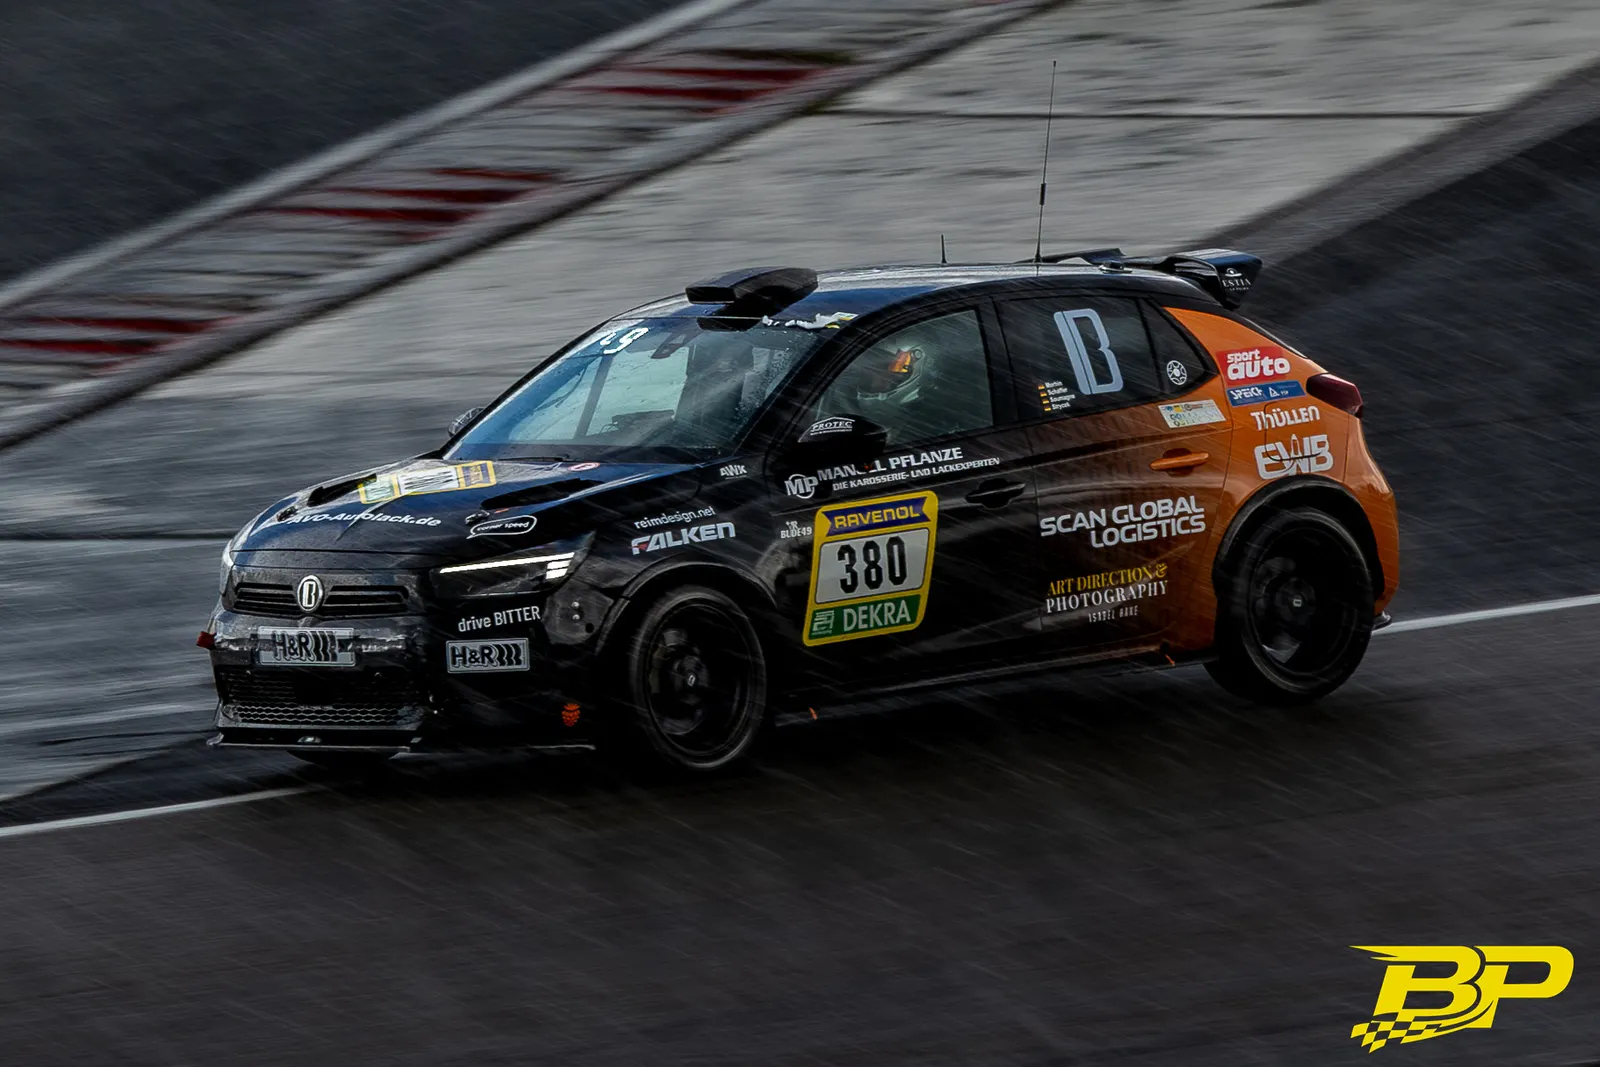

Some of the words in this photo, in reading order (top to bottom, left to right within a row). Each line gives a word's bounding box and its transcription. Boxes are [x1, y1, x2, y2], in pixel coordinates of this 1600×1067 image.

[1227, 349, 1260, 364] sport
[1227, 356, 1291, 380] auto
[812, 421, 853, 431] PROTEC
[817, 458, 887, 482] MANL
[889, 447, 964, 470] PFLANZE
[833, 481, 849, 491] DIE
[850, 471, 910, 488] KAROSSERIE-
[911, 467, 931, 479] UND
[932, 457, 1000, 475] LACKEXPERTEN
[784, 475, 819, 496] MP
[504, 521, 530, 529] speed
[834, 505, 921, 529] RAVENOL
[1040, 509, 1107, 537] SCAN
[1112, 495, 1205, 524] GLOBAL
[1090, 514, 1206, 548] LOGISTICS
[631, 522, 736, 555] FALKEN
[837, 536, 908, 594] 380
[1047, 578, 1074, 596] ART
[1077, 566, 1153, 591] DIRECTION
[1156, 563, 1168, 578] &
[1046, 580, 1168, 613] PHOTOGRAPHY
[458, 616, 491, 632] drive
[494, 606, 541, 626] BITTER
[843, 599, 911, 632] DEKRA
[272, 632, 316, 662] H&R
[450, 644, 496, 668] H&R
